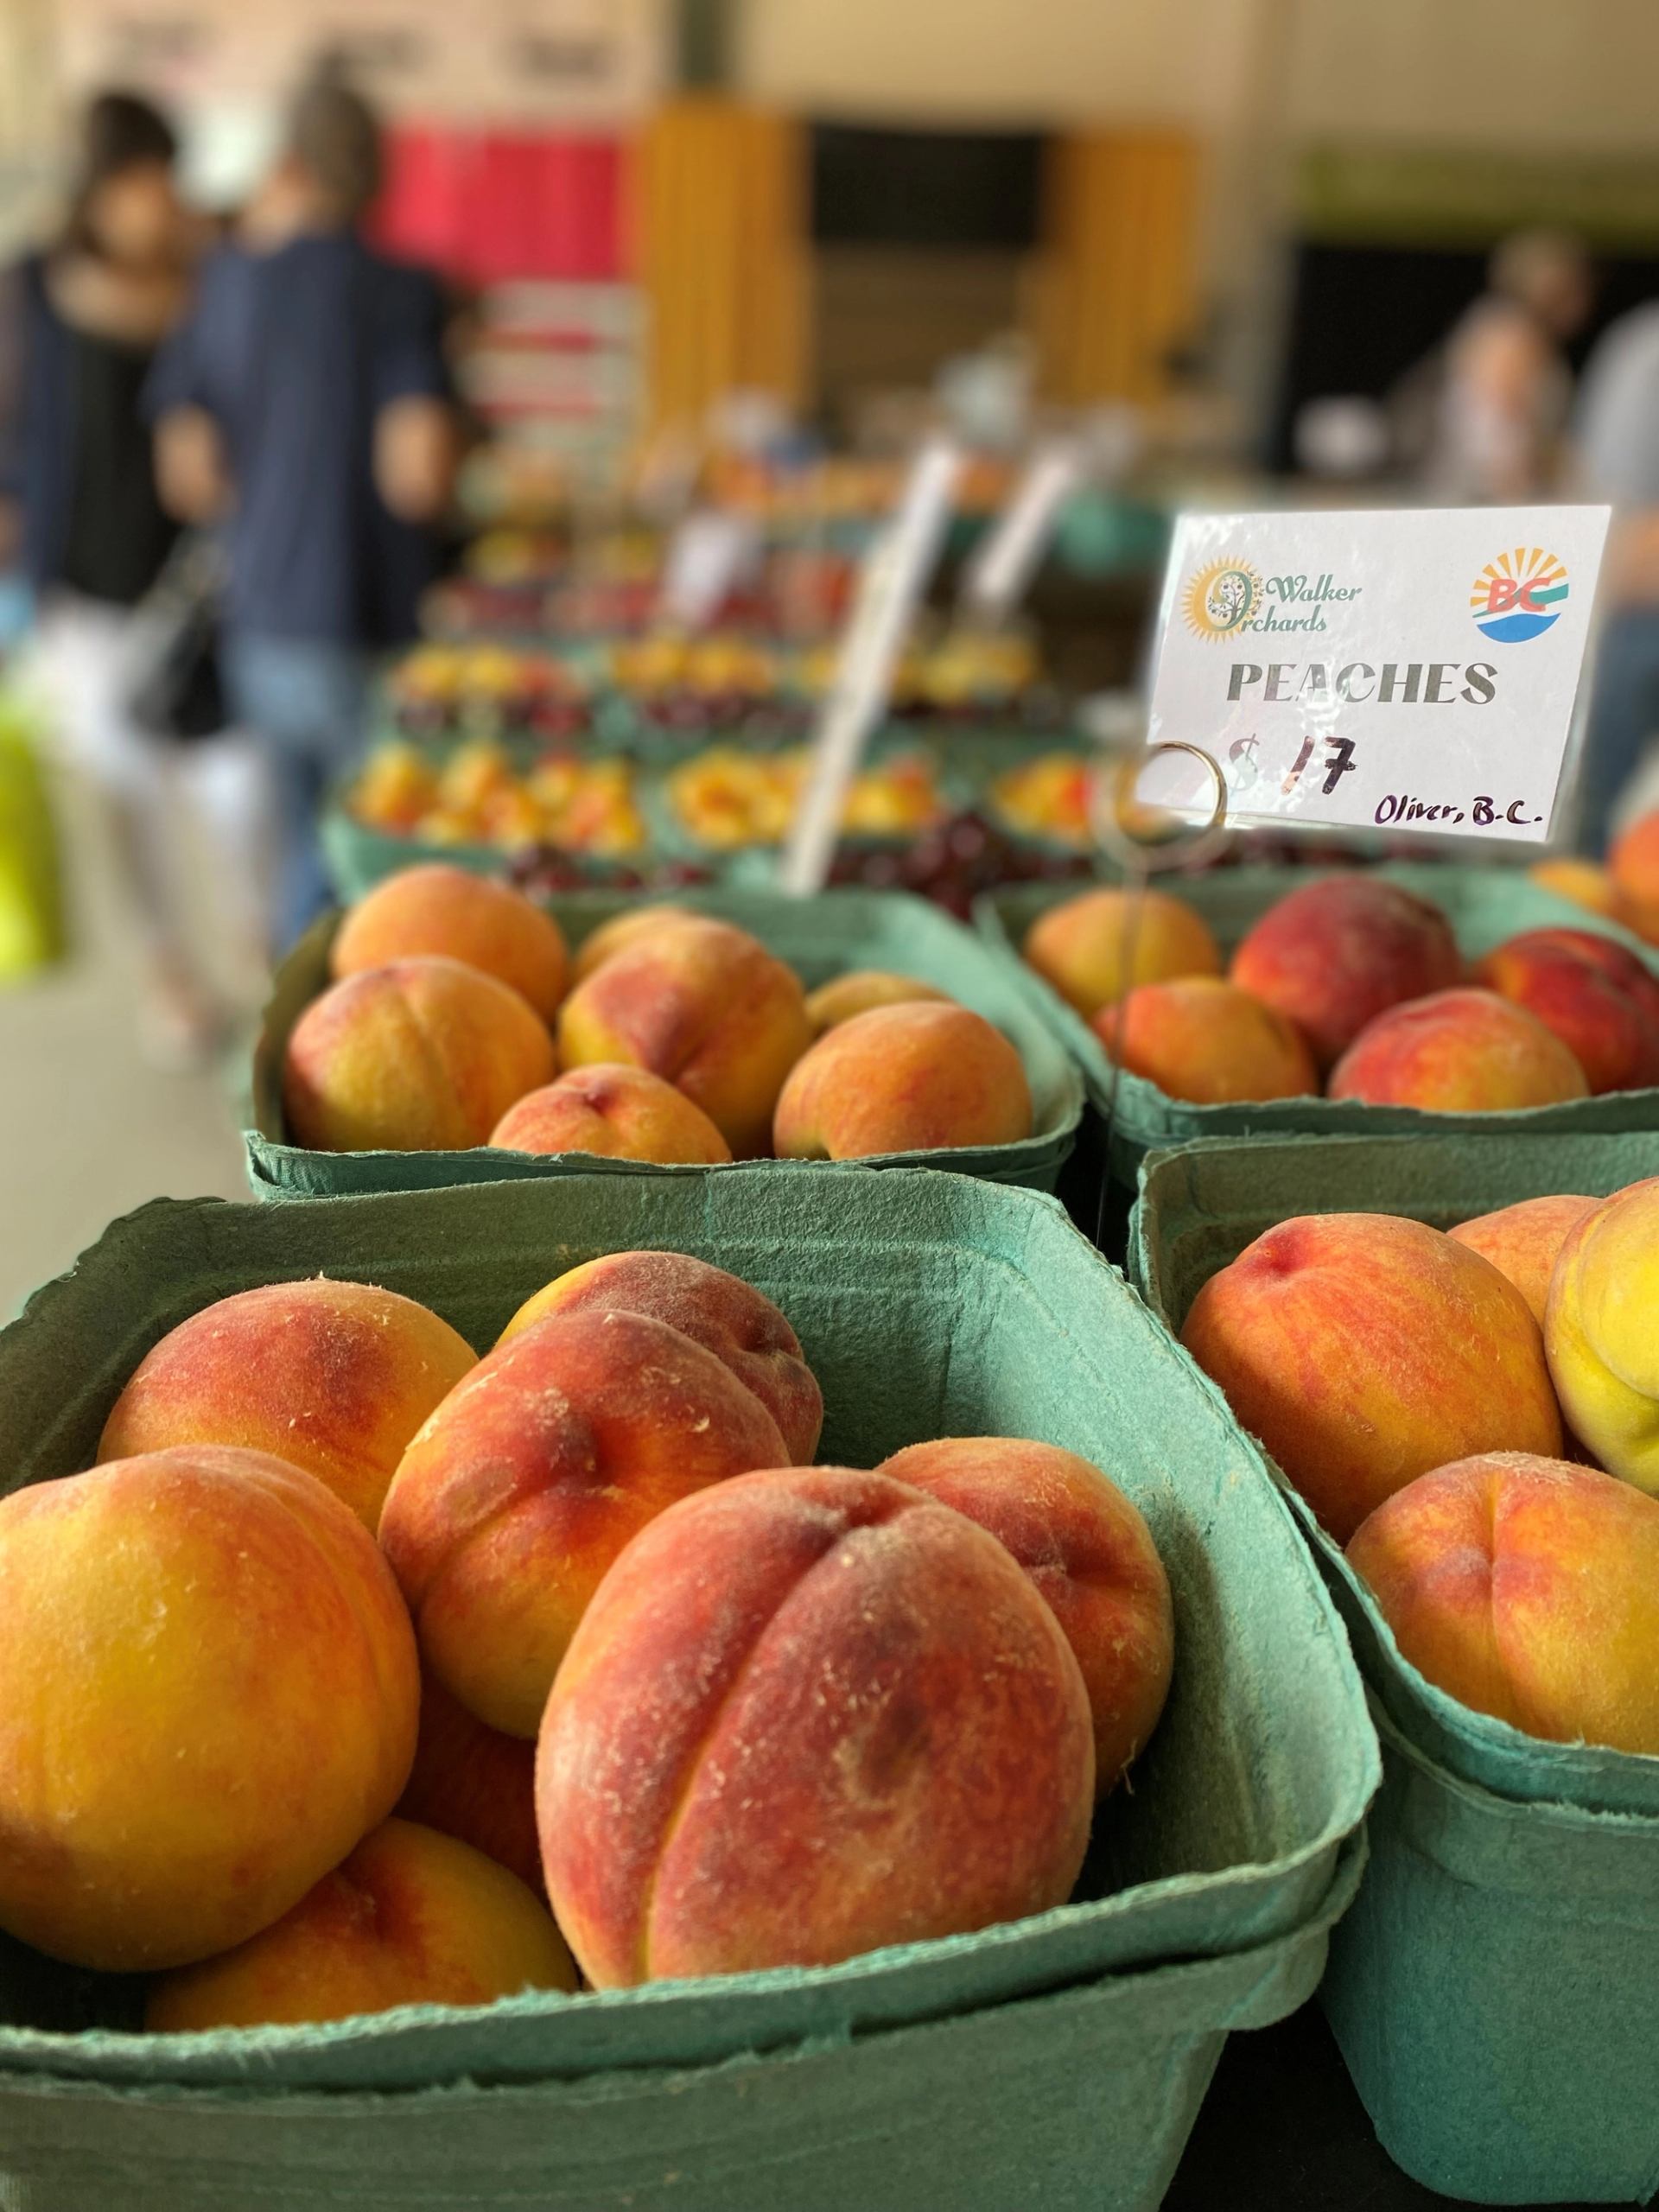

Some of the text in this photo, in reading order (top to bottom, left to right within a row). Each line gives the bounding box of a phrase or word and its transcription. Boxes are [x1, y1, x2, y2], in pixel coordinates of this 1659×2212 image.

[1265, 574, 1363, 603] Walker
[1487, 577, 1553, 613] BC
[1226, 662, 1498, 704] PEACHES
[1374, 793, 1544, 826] Oliver, B.C.
